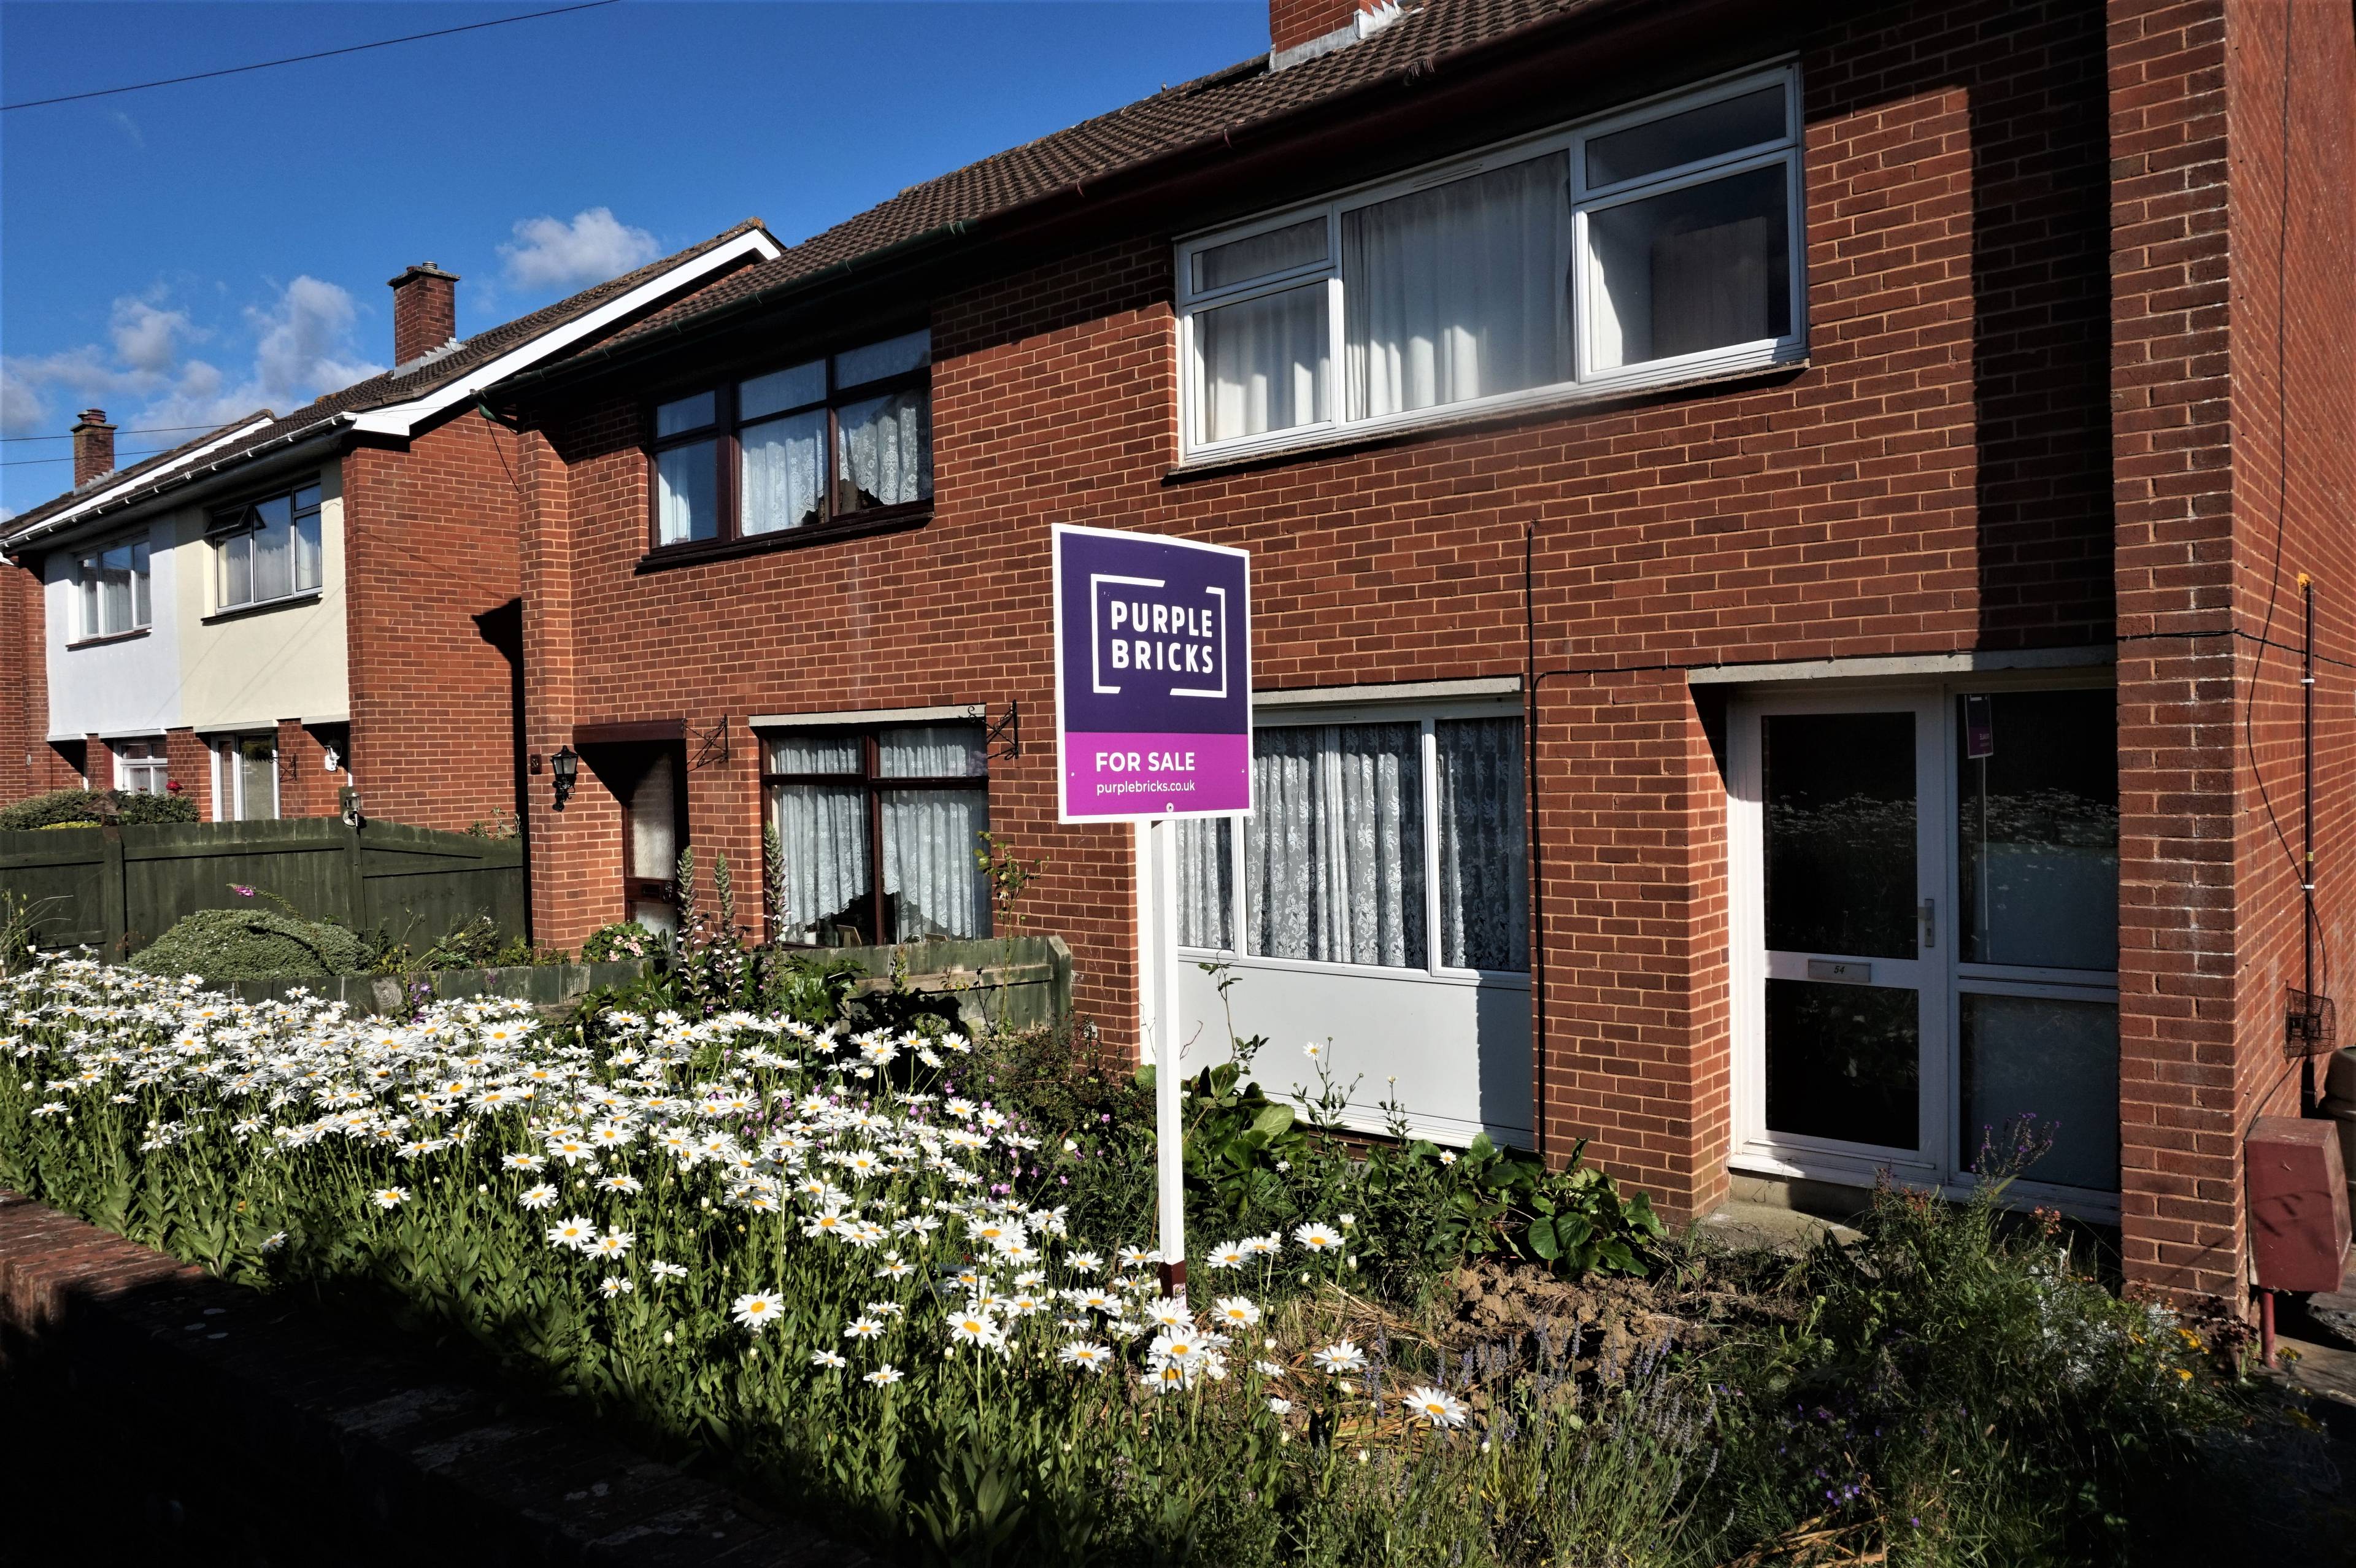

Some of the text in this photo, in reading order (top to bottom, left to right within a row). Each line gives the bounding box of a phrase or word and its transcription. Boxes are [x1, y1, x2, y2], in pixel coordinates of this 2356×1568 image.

[1112, 601, 1212, 637] PURPLE
[1112, 639, 1213, 674] BRICKS
[1096, 752, 1195, 772] FOR SALE
[1096, 780, 1195, 796] purplebricks.co.uk
[1833, 966, 1846, 974] 54
